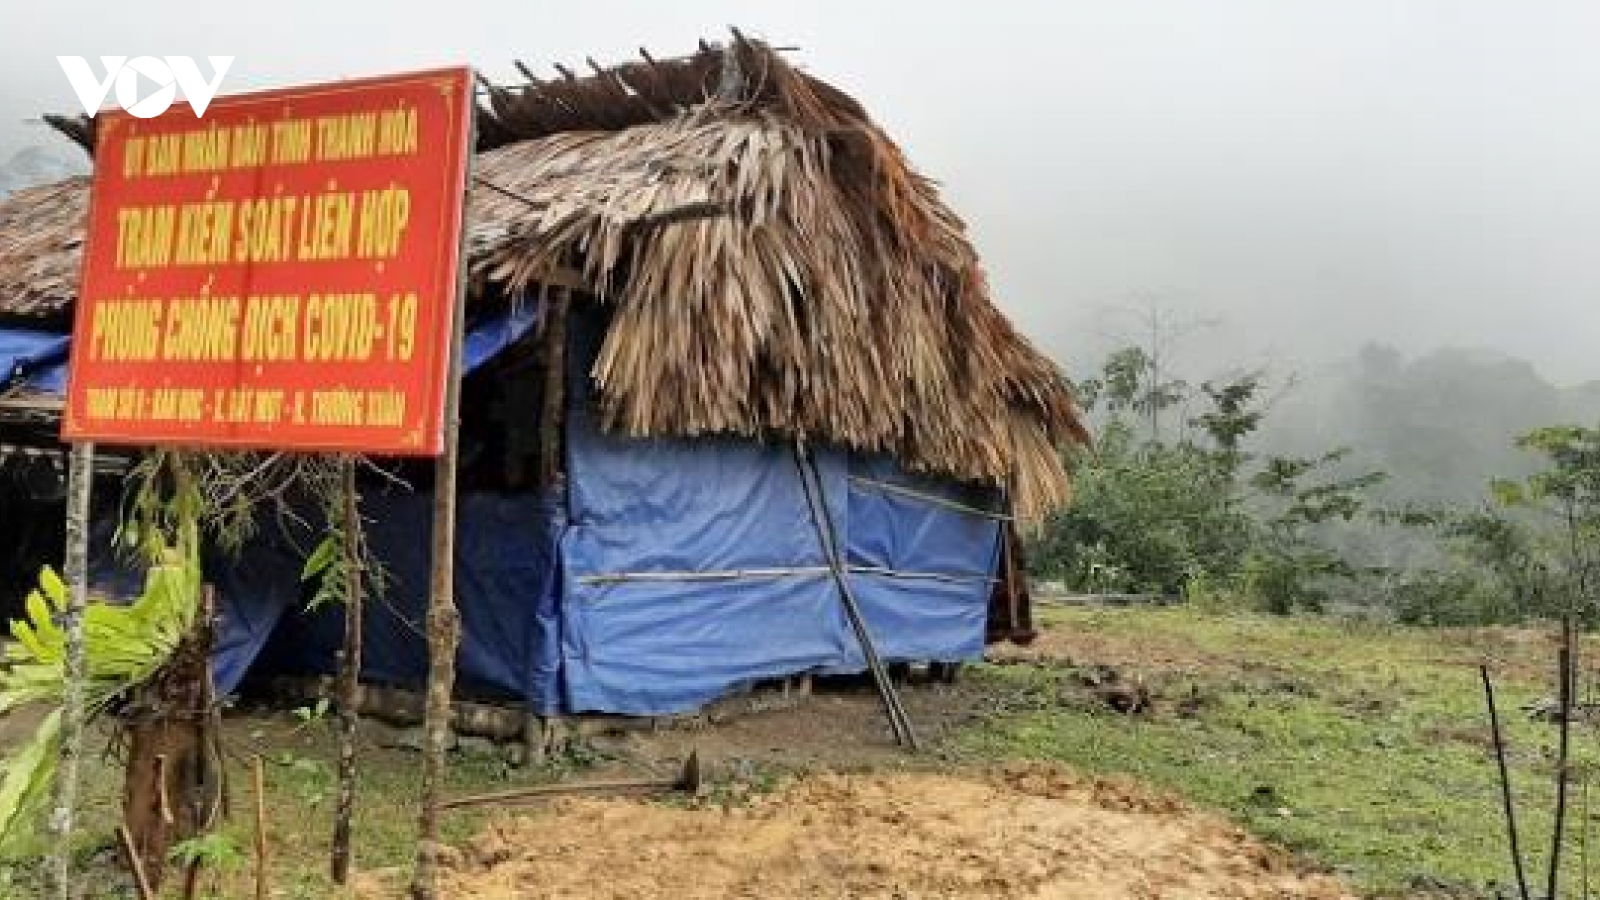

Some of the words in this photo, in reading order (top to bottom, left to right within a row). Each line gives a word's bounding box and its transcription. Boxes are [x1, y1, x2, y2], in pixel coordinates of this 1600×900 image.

[147, 134, 180, 177] BAN
[316, 112, 376, 161] THANH
[116, 205, 175, 283] TRẠM
[176, 177, 234, 264] KIỂM
[235, 183, 297, 262] SOÁT
[298, 178, 356, 262] LIÊN
[357, 180, 411, 275] HỢP
[90, 284, 162, 362] PHÒNG
[164, 272, 240, 361] CHỐNG
[242, 294, 299, 375] DỊCH
[303, 292, 418, 362] COVID-19
